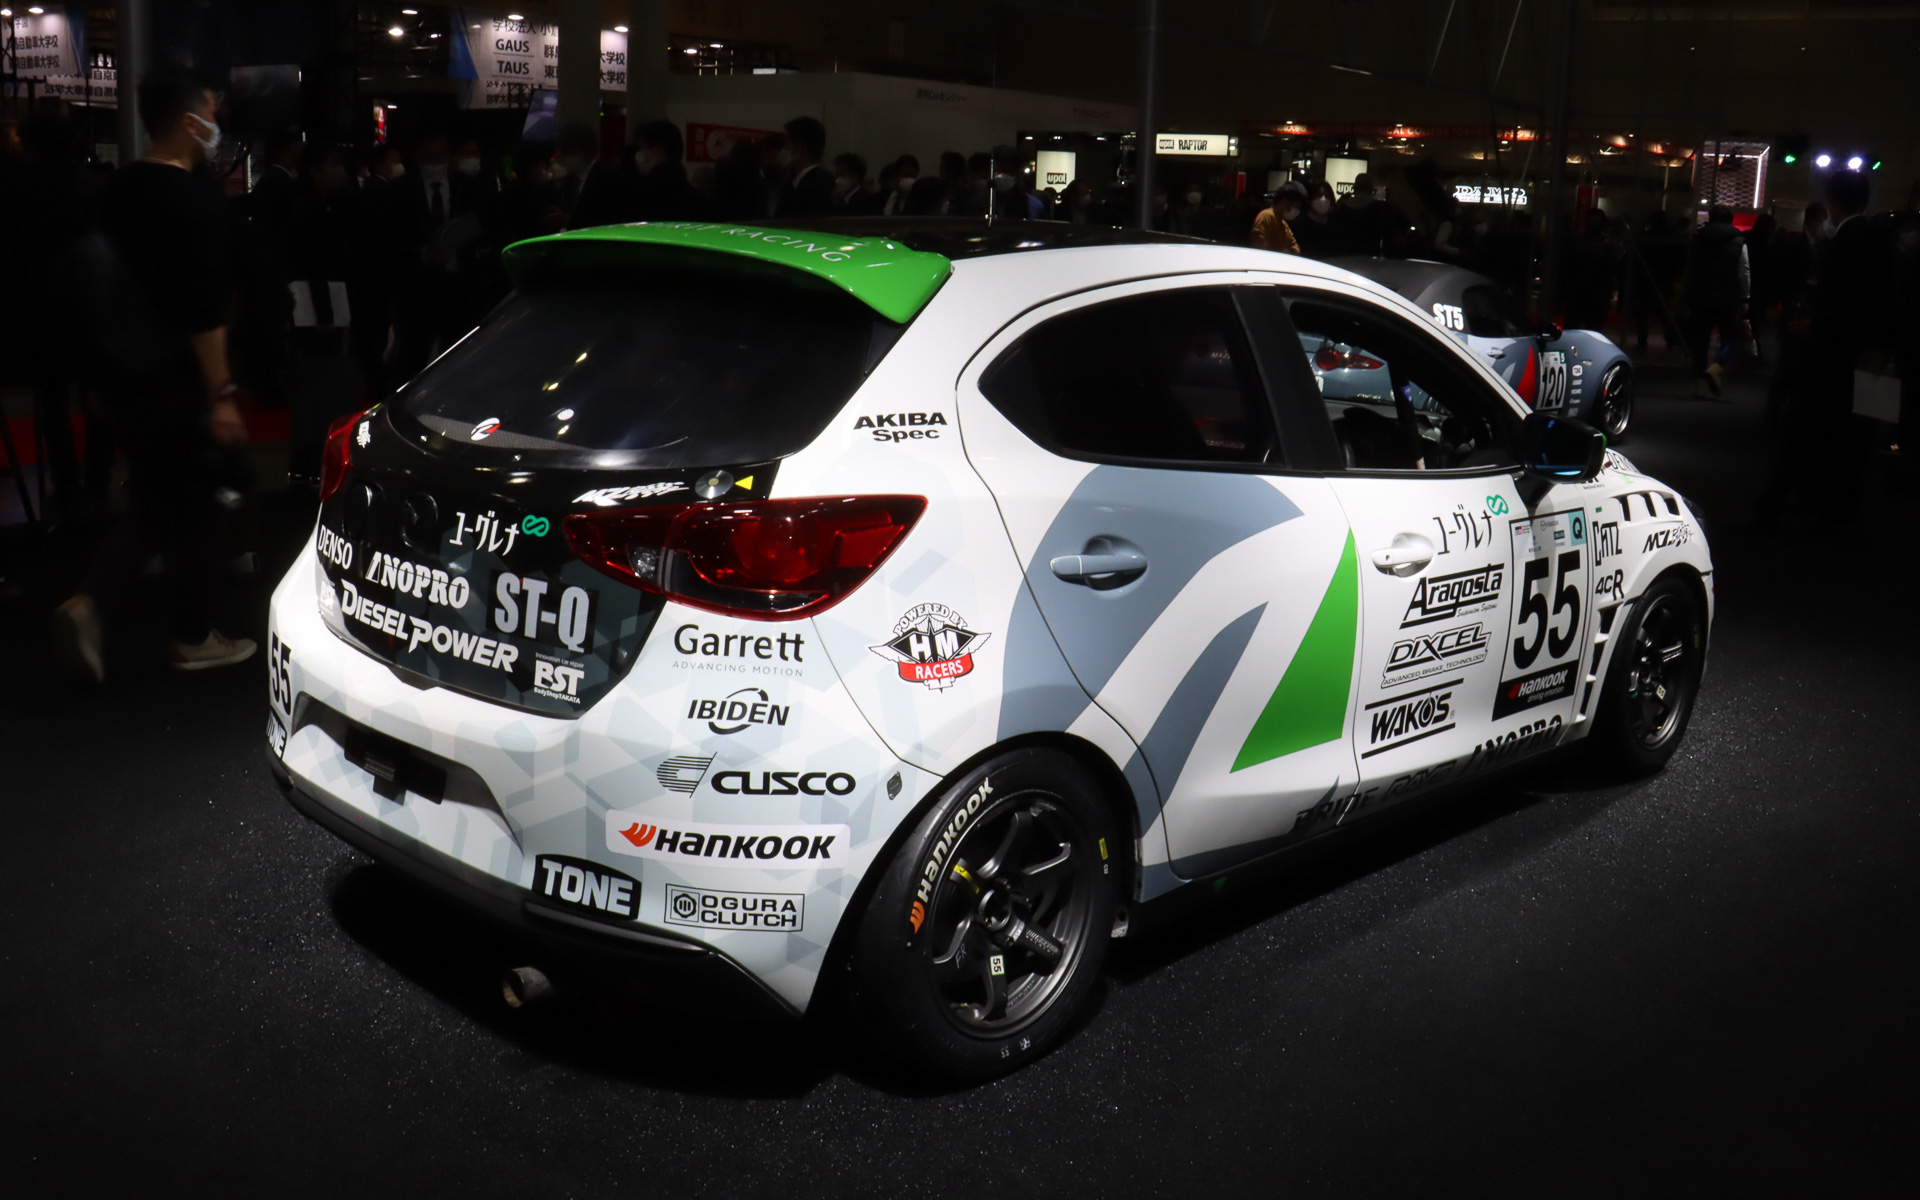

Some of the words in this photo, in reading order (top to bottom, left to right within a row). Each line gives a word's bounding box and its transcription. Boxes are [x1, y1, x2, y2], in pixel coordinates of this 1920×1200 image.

[495, 38, 530, 53] GAUS
[497, 60, 530, 75] TAUS
[1178, 140, 1207, 151] RAPTOR
[720, 228, 851, 262] RACING
[1433, 303, 1464, 331] ST5
[1542, 366, 1565, 407] 120
[854, 412, 947, 430] AKIBA
[872, 429, 940, 443] Spec
[1572, 516, 1583, 540] Q
[317, 524, 353, 570] DENSO
[1402, 563, 1504, 622] Aragosta
[494, 571, 591, 653] ST-Q
[894, 603, 950, 637] POWERED
[949, 611, 968, 630] BY
[1513, 549, 1581, 670] 55
[673, 624, 805, 662] Garrett
[1389, 625, 1488, 664] DIXCEL
[271, 631, 291, 716] 55
[534, 659, 585, 696] BST
[672, 660, 747, 673] ADVANCING
[752, 666, 803, 677] MOTION
[915, 659, 964, 679] RACERS
[1383, 671, 1421, 686] ADVANCED
[1421, 664, 1444, 676] BRAKE
[1445, 653, 1487, 669] TECHNOLOGY
[687, 699, 791, 726] IBIDEN
[1370, 691, 1453, 745] WAKO'S
[711, 770, 857, 796] CUSCO
[542, 858, 634, 917] TONE
[701, 893, 798, 912] OGURA
[701, 909, 798, 927] CLUTCH
[992, 958, 1002, 973] 55
